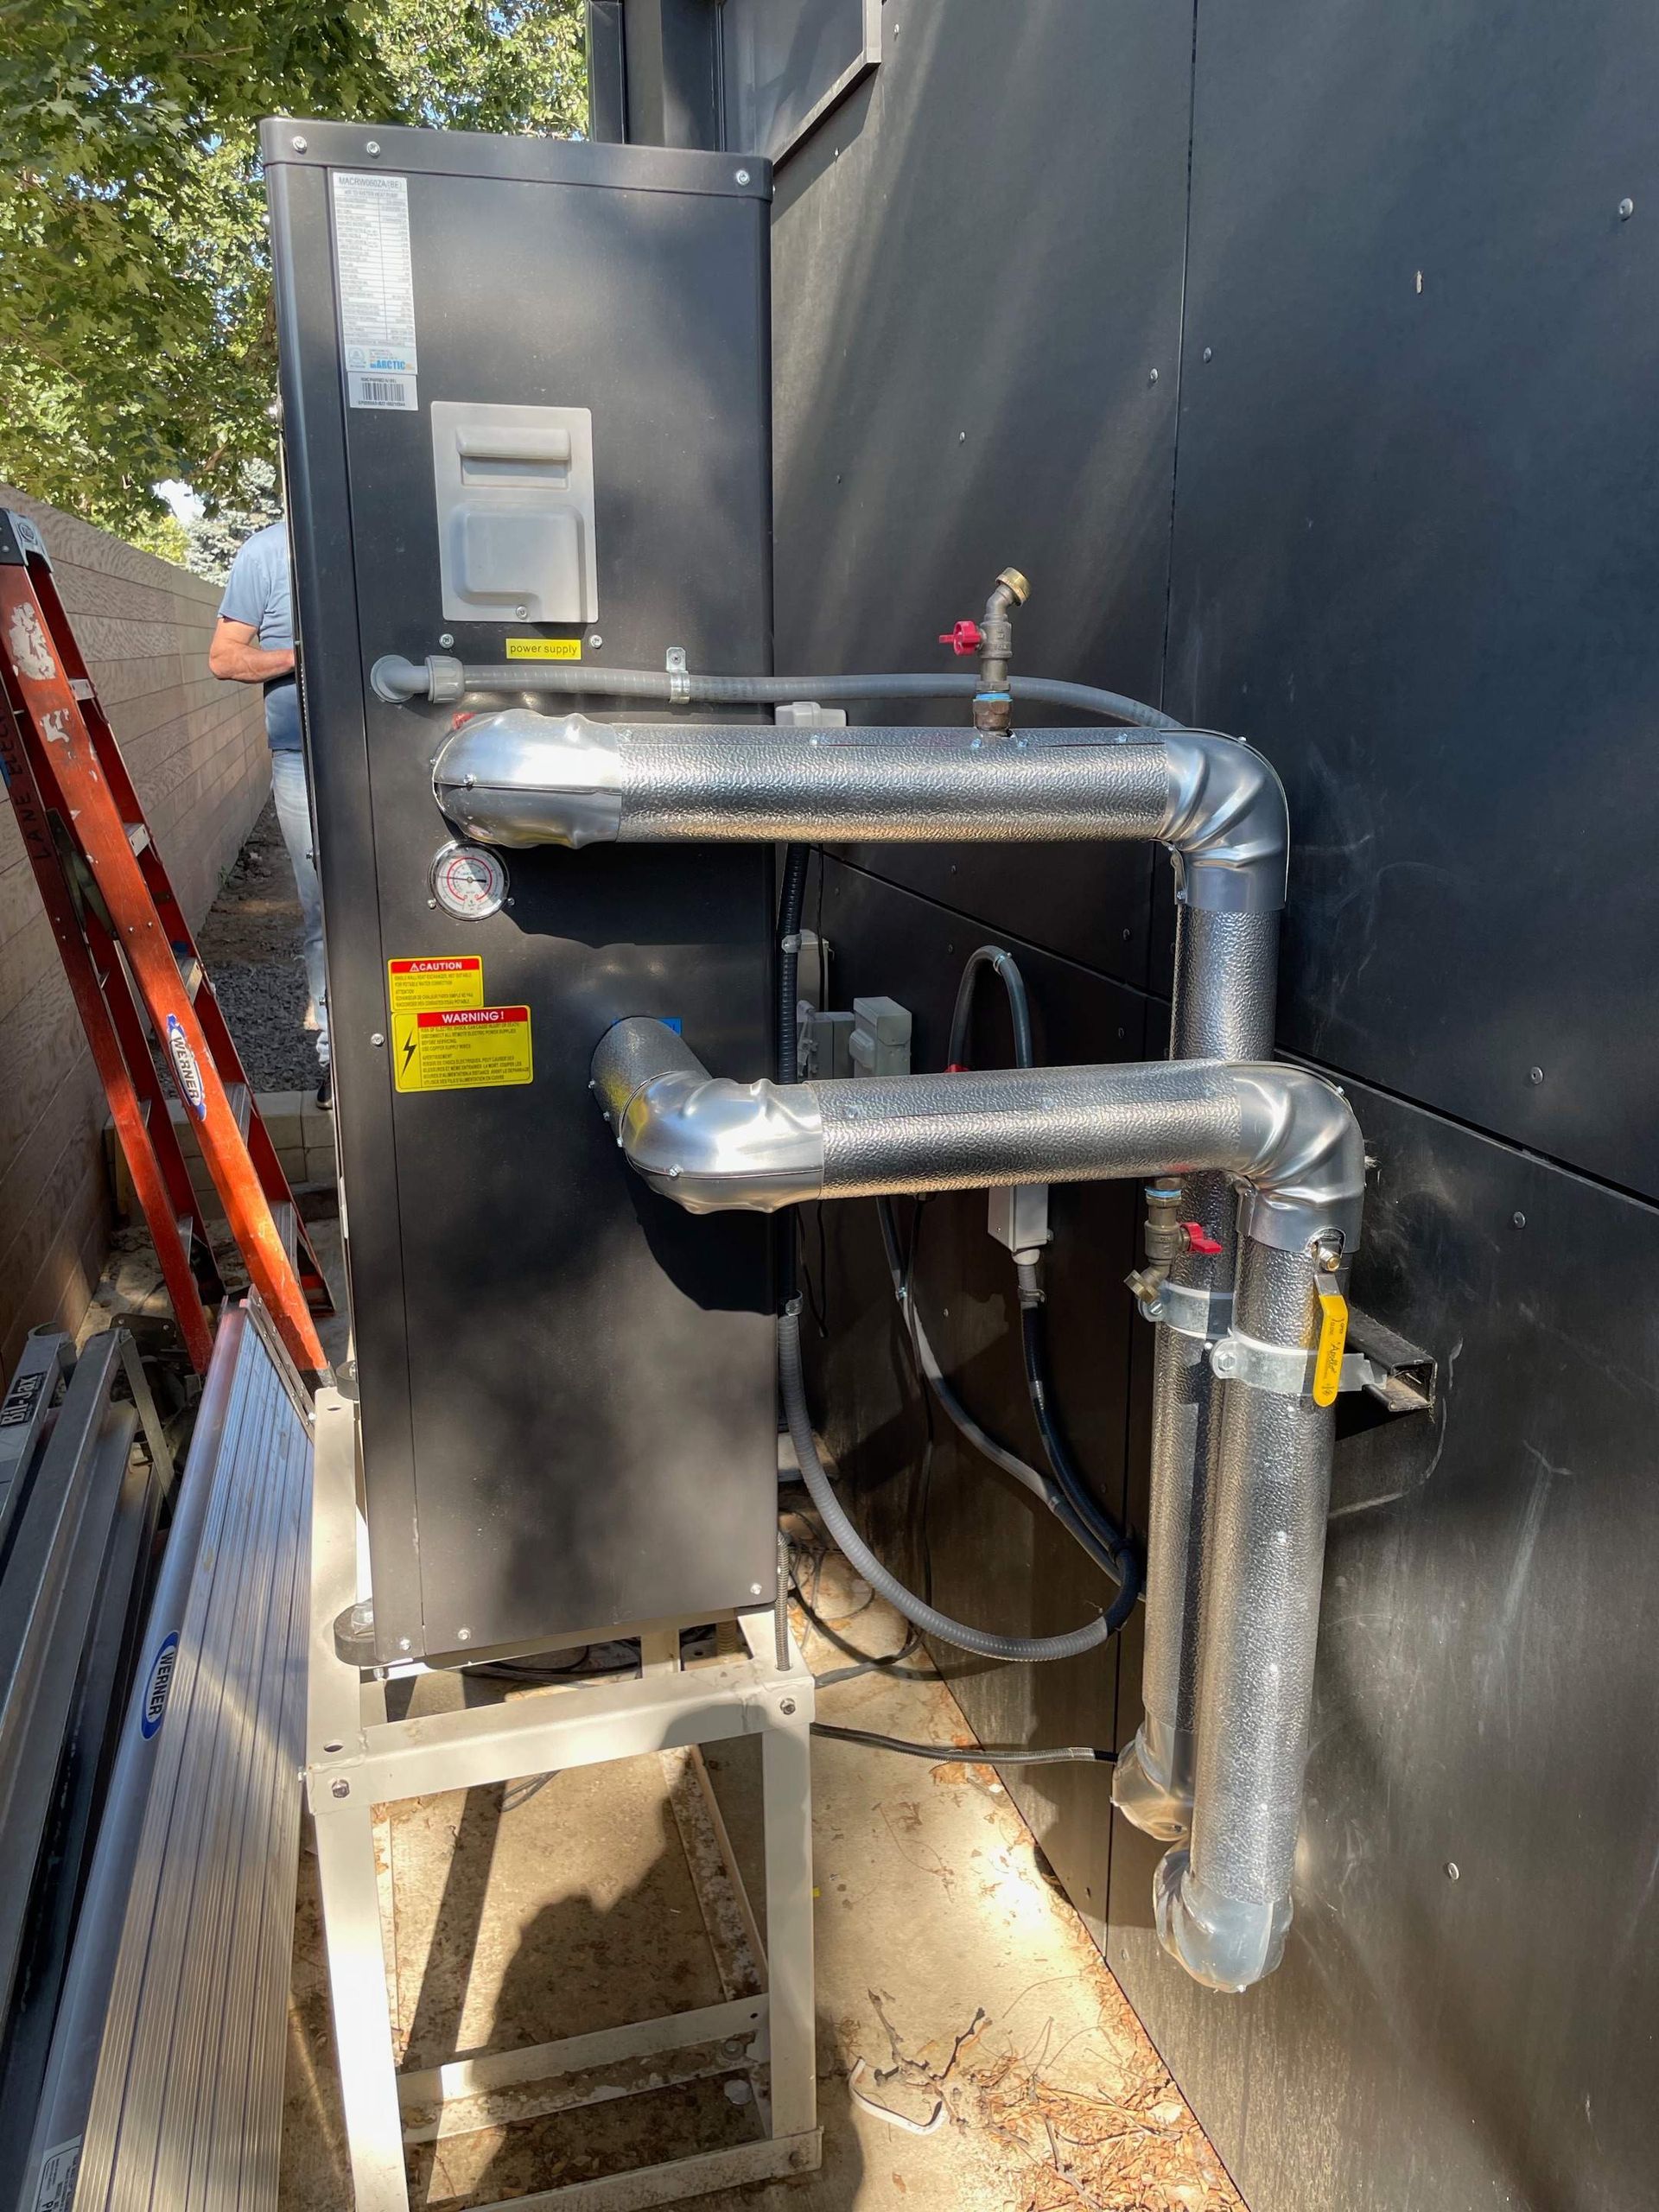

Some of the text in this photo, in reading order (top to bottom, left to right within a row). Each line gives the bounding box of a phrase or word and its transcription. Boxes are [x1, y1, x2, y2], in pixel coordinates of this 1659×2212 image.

[377, 359, 405, 370] ARCTIC
[511, 643, 577, 656] power supply
[16, 792, 52, 860] LANE
[420, 962, 462, 971] CAUTION
[172, 1037, 200, 1099] WERNER
[0, 1375, 38, 1426] Bil-Jax
[148, 1651, 175, 1716] WERNER
